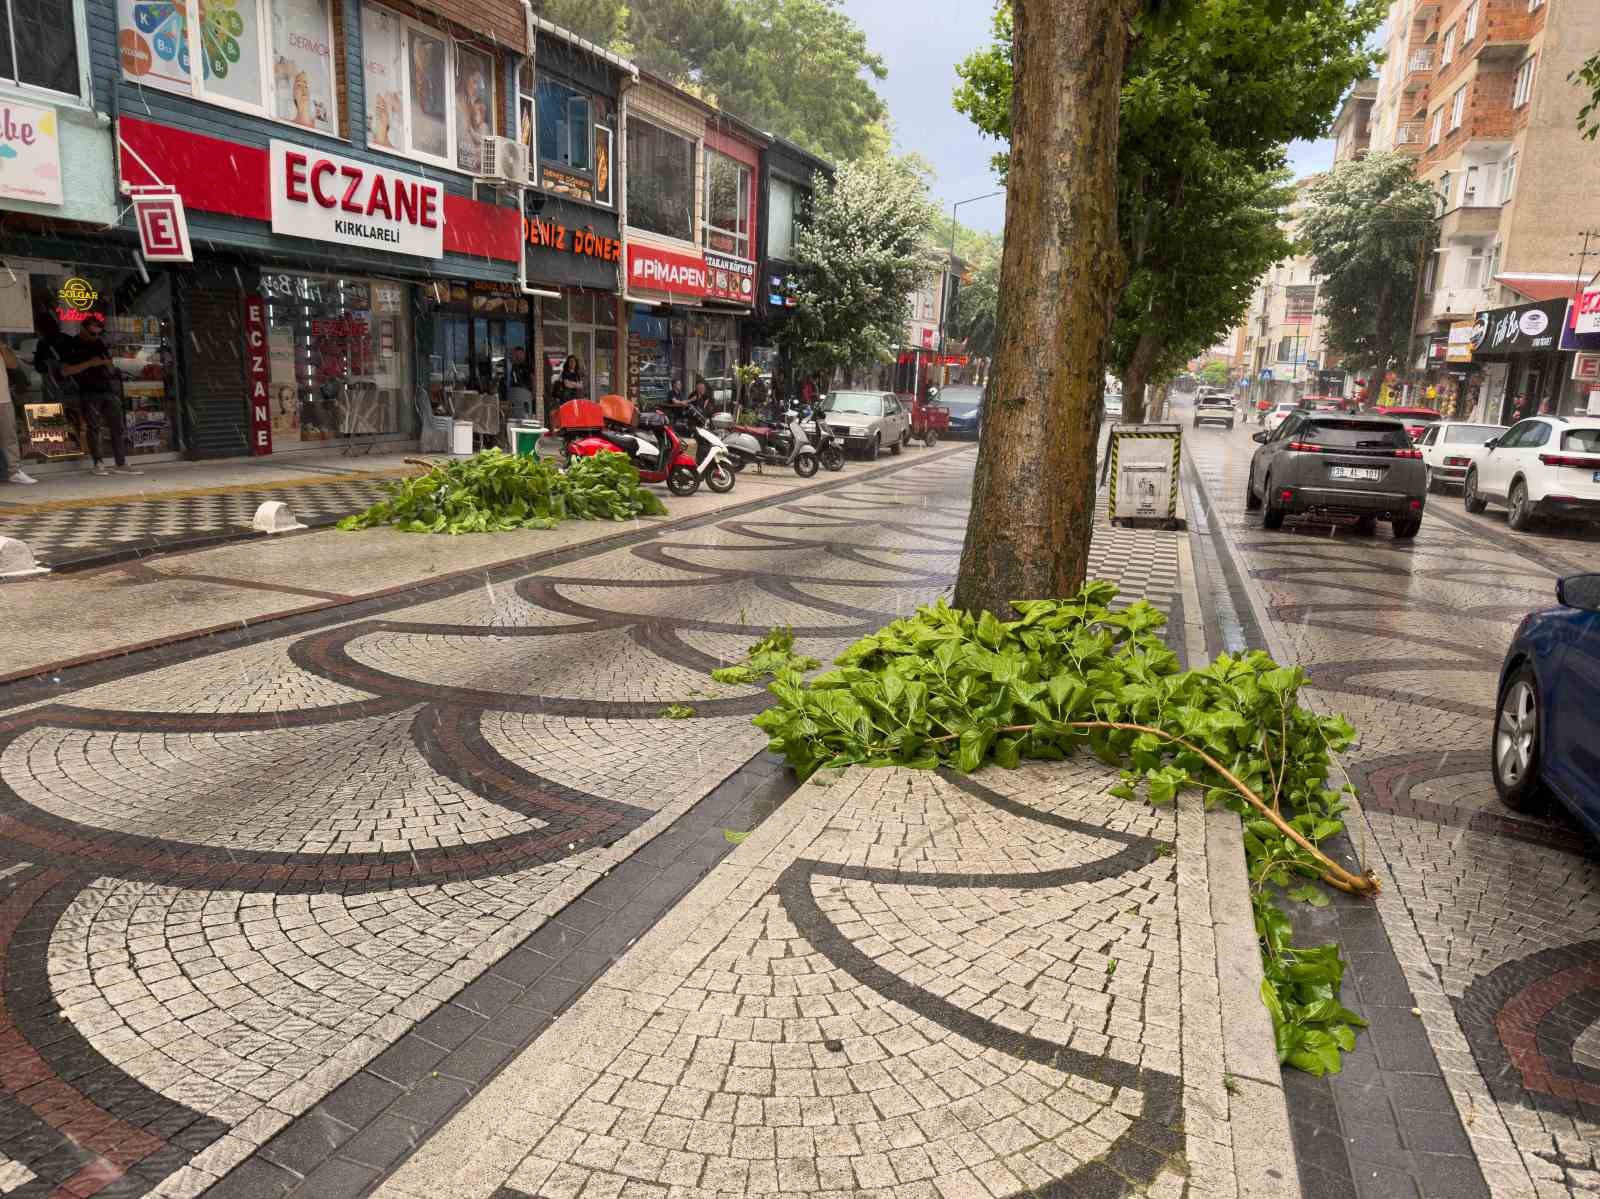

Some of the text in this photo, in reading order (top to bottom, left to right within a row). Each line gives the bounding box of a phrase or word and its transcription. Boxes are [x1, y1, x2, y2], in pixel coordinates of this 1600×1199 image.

[285, 150, 438, 229] ECZANE
[150, 212, 174, 246] E
[334, 219, 401, 244] KIRKLARELİ
[574, 224, 622, 263] DÖNER
[58, 288, 98, 300] SOLGAR
[249, 305, 269, 446] ECZANE
